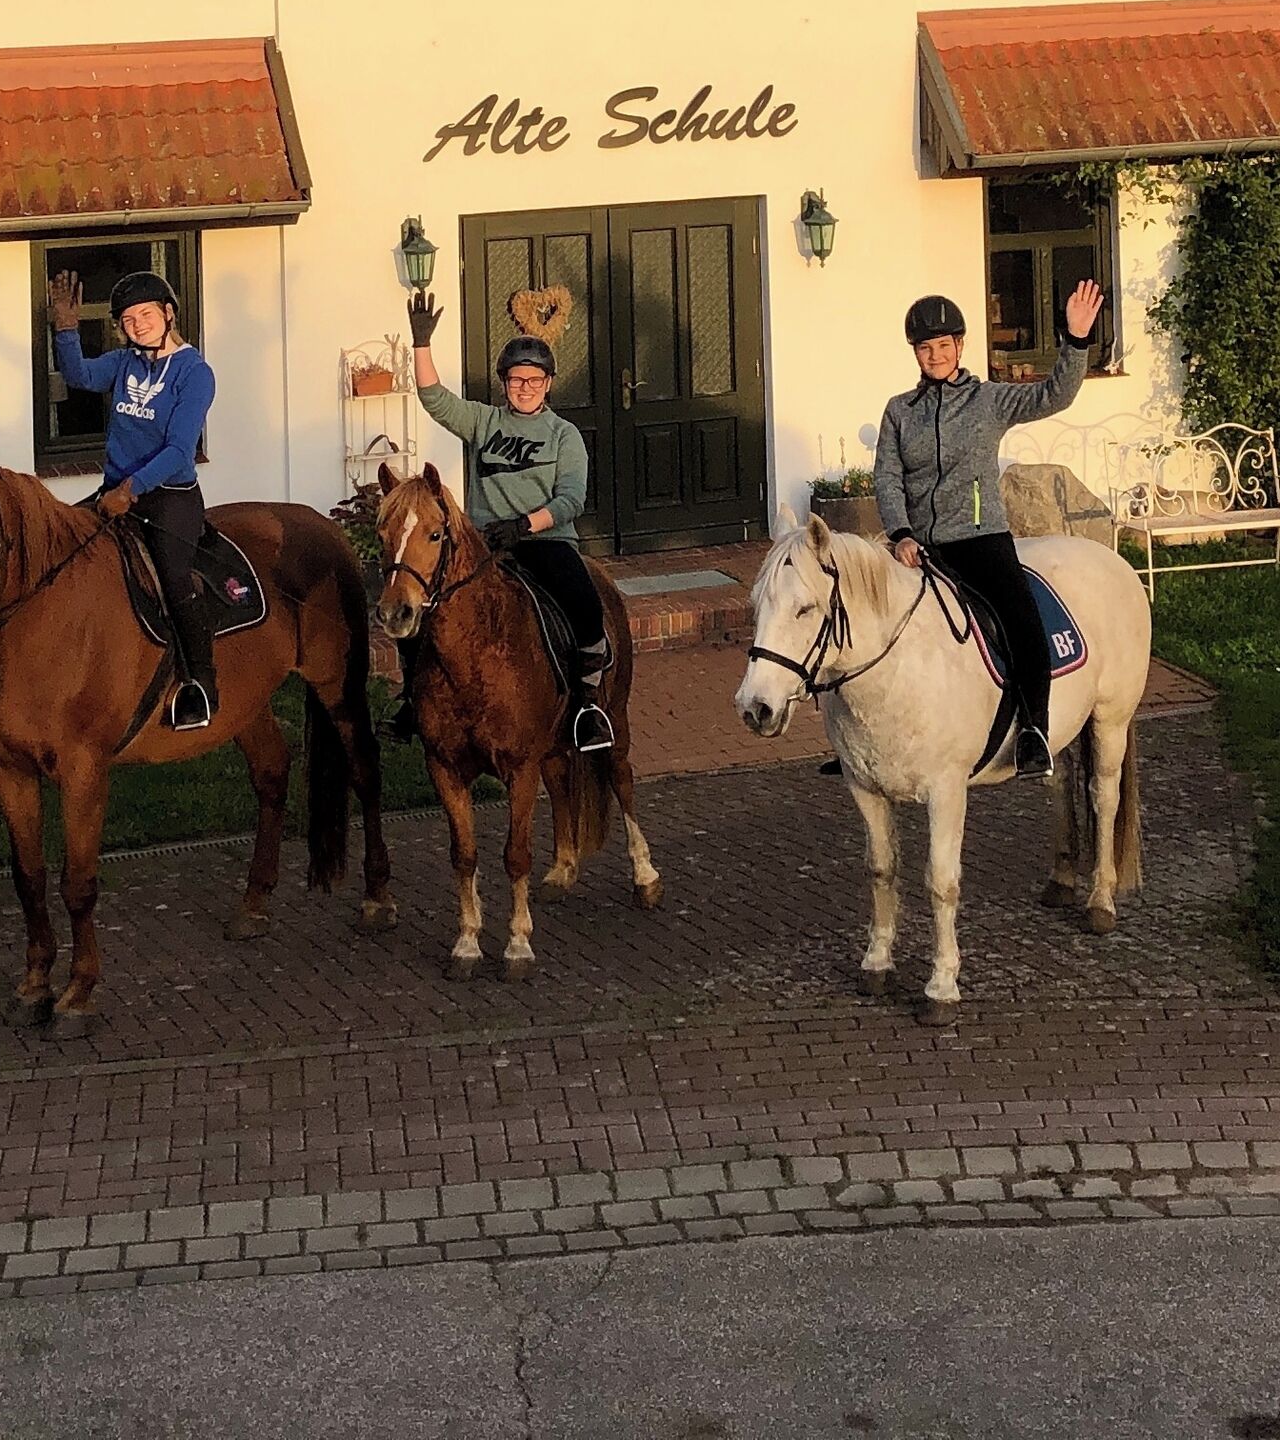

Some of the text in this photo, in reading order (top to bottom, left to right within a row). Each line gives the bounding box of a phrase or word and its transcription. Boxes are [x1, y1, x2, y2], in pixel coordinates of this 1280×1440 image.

[422, 84, 799, 163] Alte Schule
[116, 401, 156, 421] adidas
[483, 429, 546, 463] NIKE
[1051, 630, 1076, 659] BF
